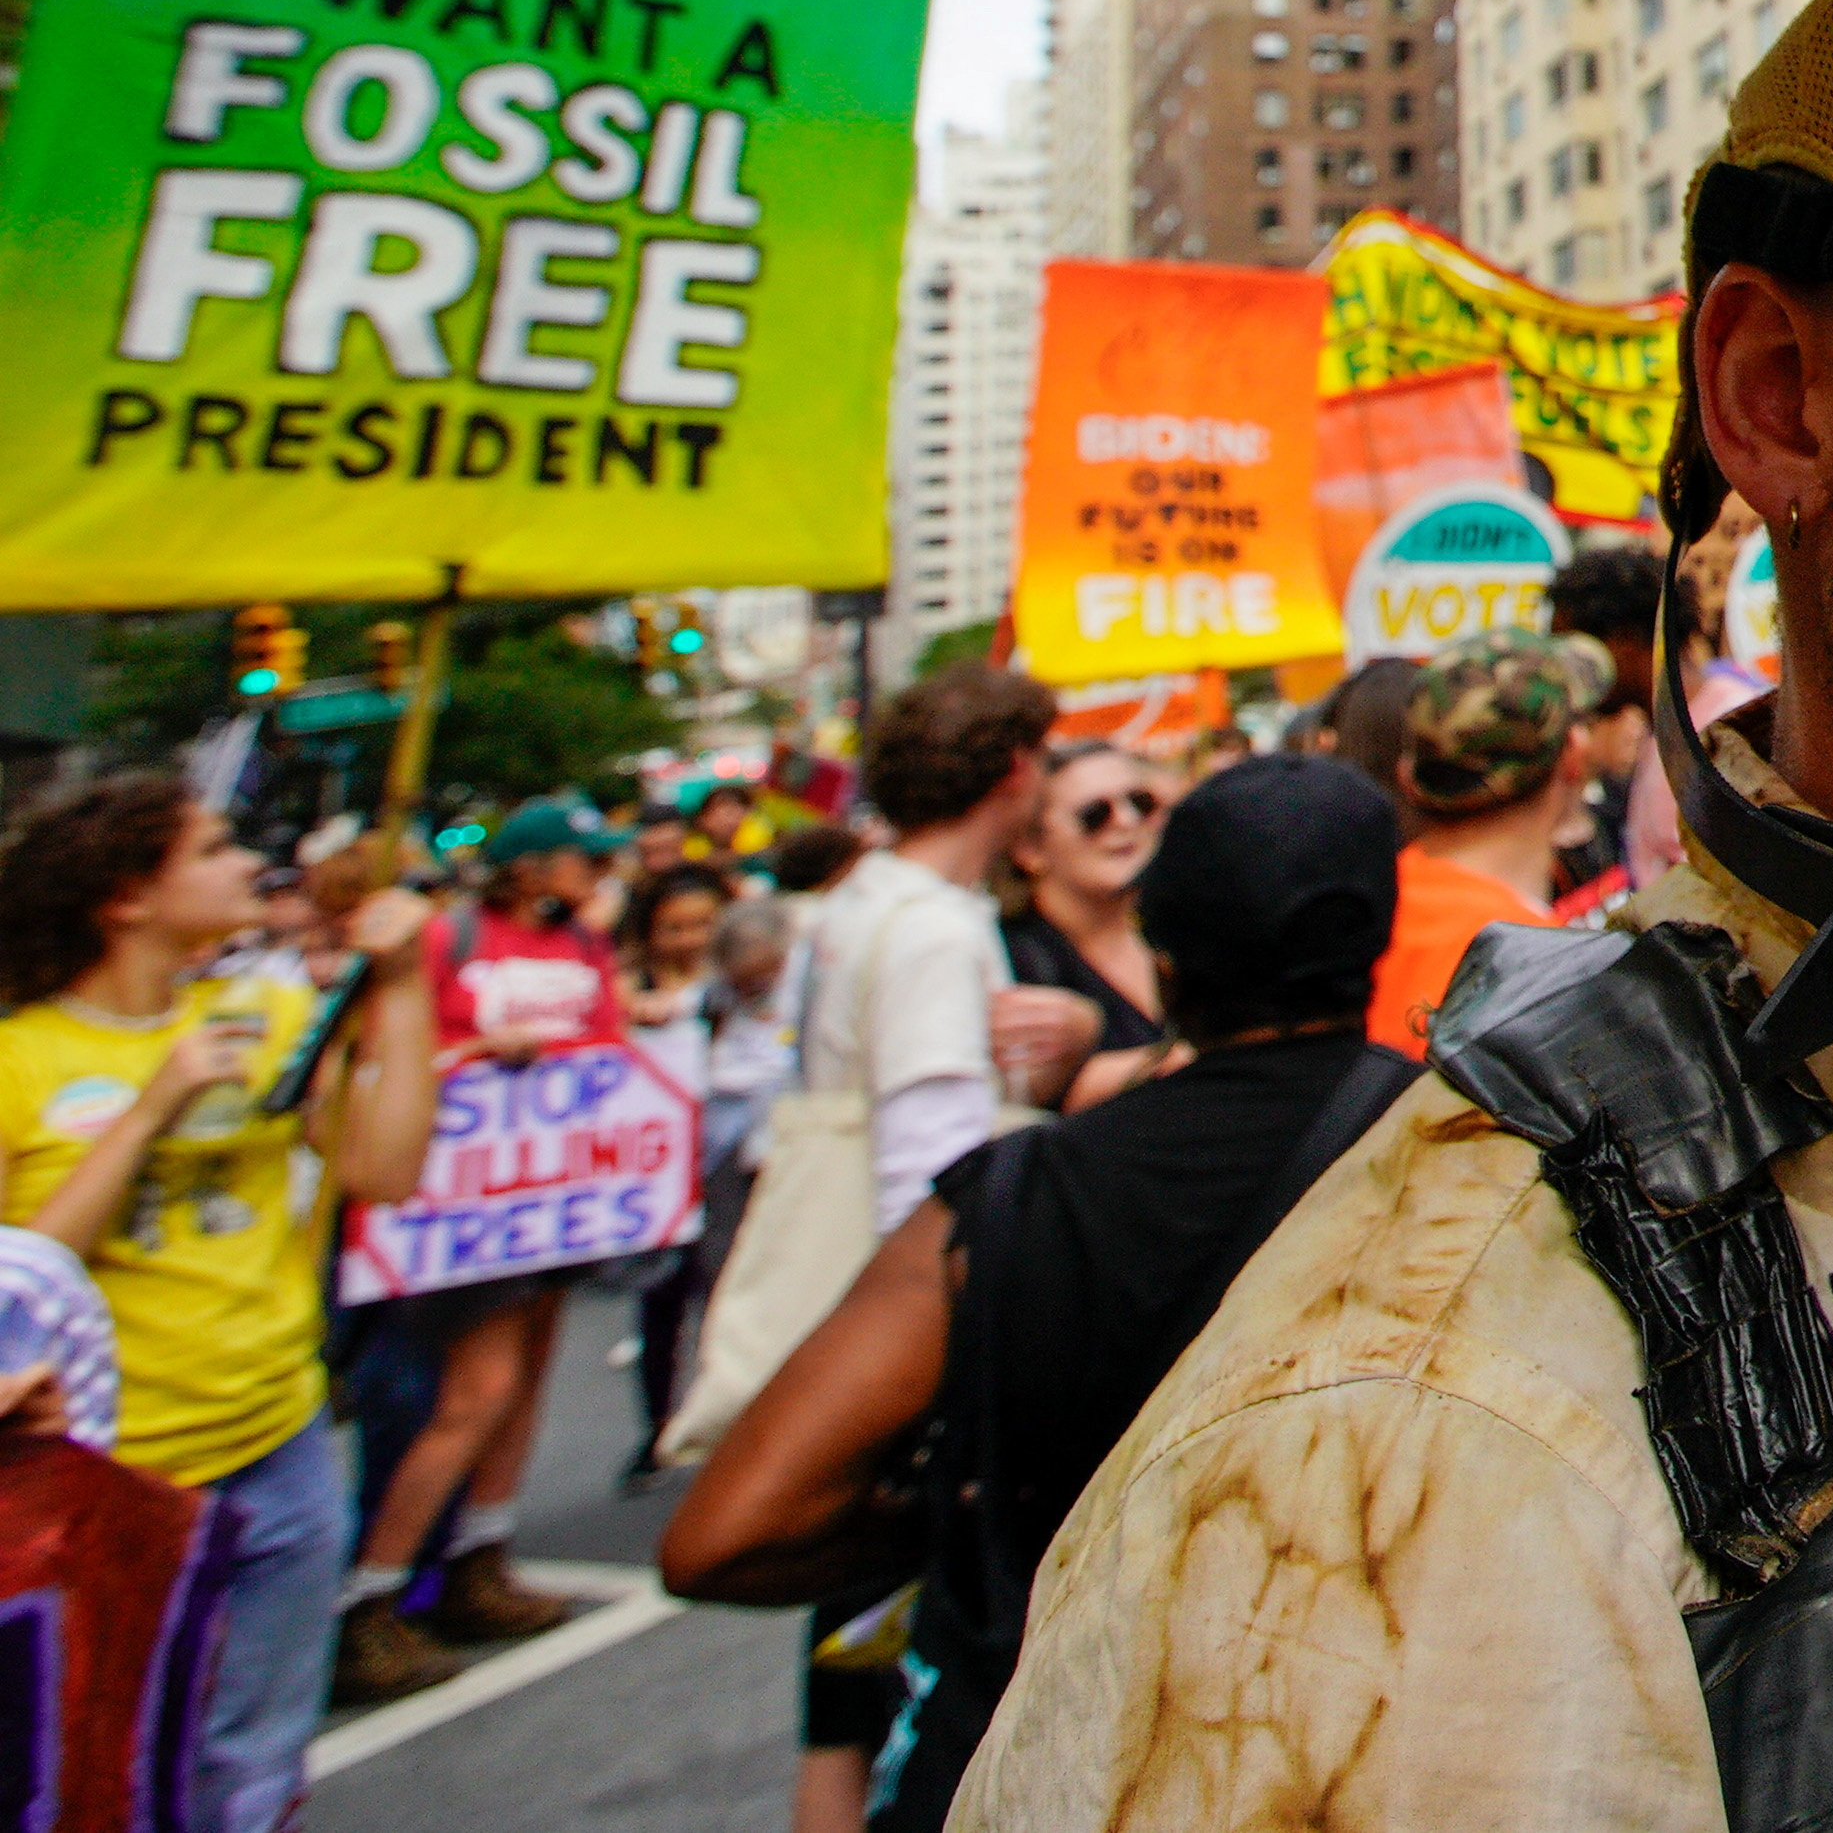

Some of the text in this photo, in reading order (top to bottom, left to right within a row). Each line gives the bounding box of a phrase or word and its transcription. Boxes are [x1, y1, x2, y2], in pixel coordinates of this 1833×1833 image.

[712, 19, 782, 100] A
[162, 16, 763, 232] FOSSIL
[113, 165, 765, 412] FREE
[85, 388, 731, 493] PRESIDENT
[1074, 570, 1283, 644] FIRE
[1374, 580, 1548, 642] VOTE
[435, 1056, 629, 1139] STOP
[430, 1119, 672, 1204] ILLING
[393, 1182, 652, 1280] TREES
